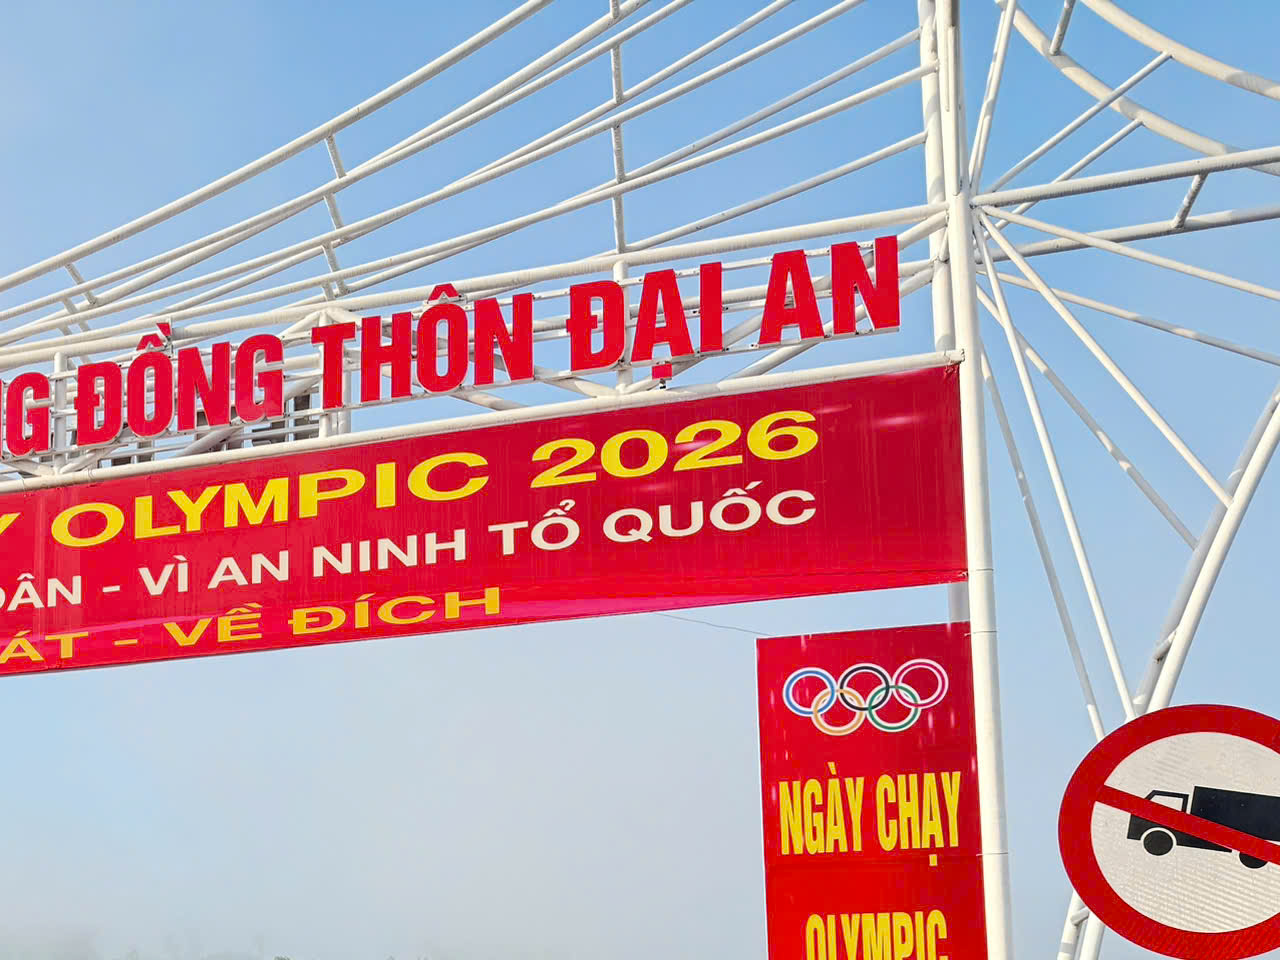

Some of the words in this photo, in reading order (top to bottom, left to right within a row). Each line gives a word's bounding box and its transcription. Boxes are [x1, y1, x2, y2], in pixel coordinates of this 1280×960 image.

[74, 321, 284, 447] ĐỒNG
[312, 283, 533, 411] THÔN
[566, 261, 725, 380] ĐẠI
[757, 236, 901, 346] AN
[51, 451, 491, 549] OLYMPIC
[531, 409, 821, 488] 2026
[138, 555, 190, 597] VÌ
[207, 551, 292, 591] AN
[313, 529, 467, 577] NINH
[488, 498, 581, 556] TỔ
[602, 479, 818, 544] QUỐC
[163, 602, 264, 648] VỀ
[288, 585, 502, 636] ĐÍCH
[778, 761, 865, 855] NGÀY
[876, 771, 961, 867] CHẠY
